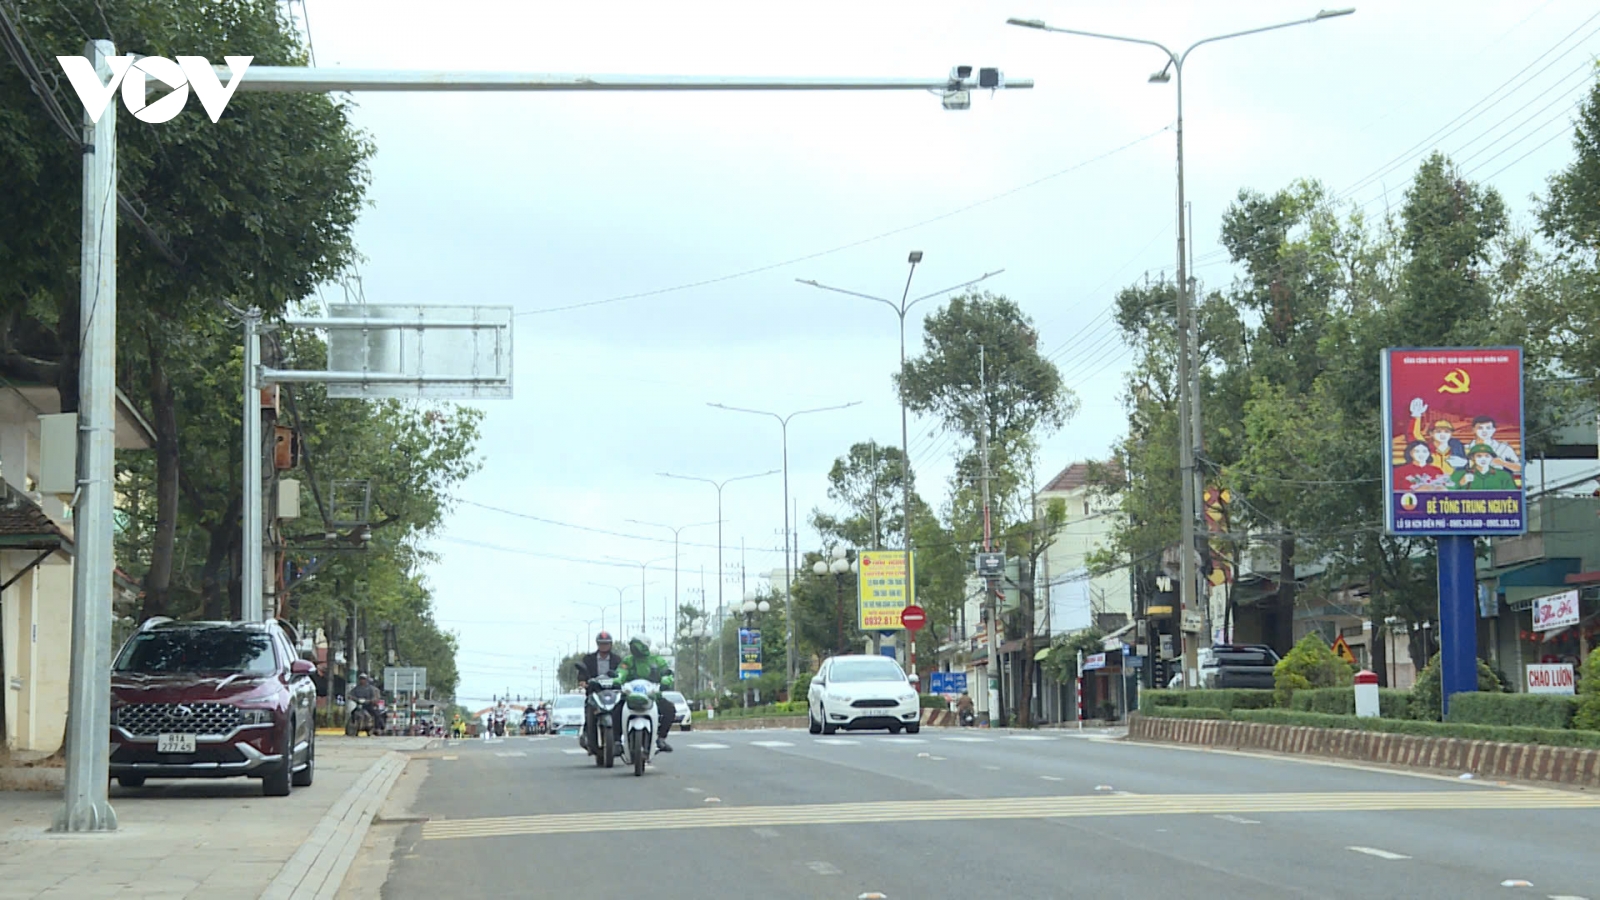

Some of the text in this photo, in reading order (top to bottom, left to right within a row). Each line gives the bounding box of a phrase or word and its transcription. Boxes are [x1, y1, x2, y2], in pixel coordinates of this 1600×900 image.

[1426, 496, 1519, 514] BÊ TÔNG TRUNG NGUYÊN
